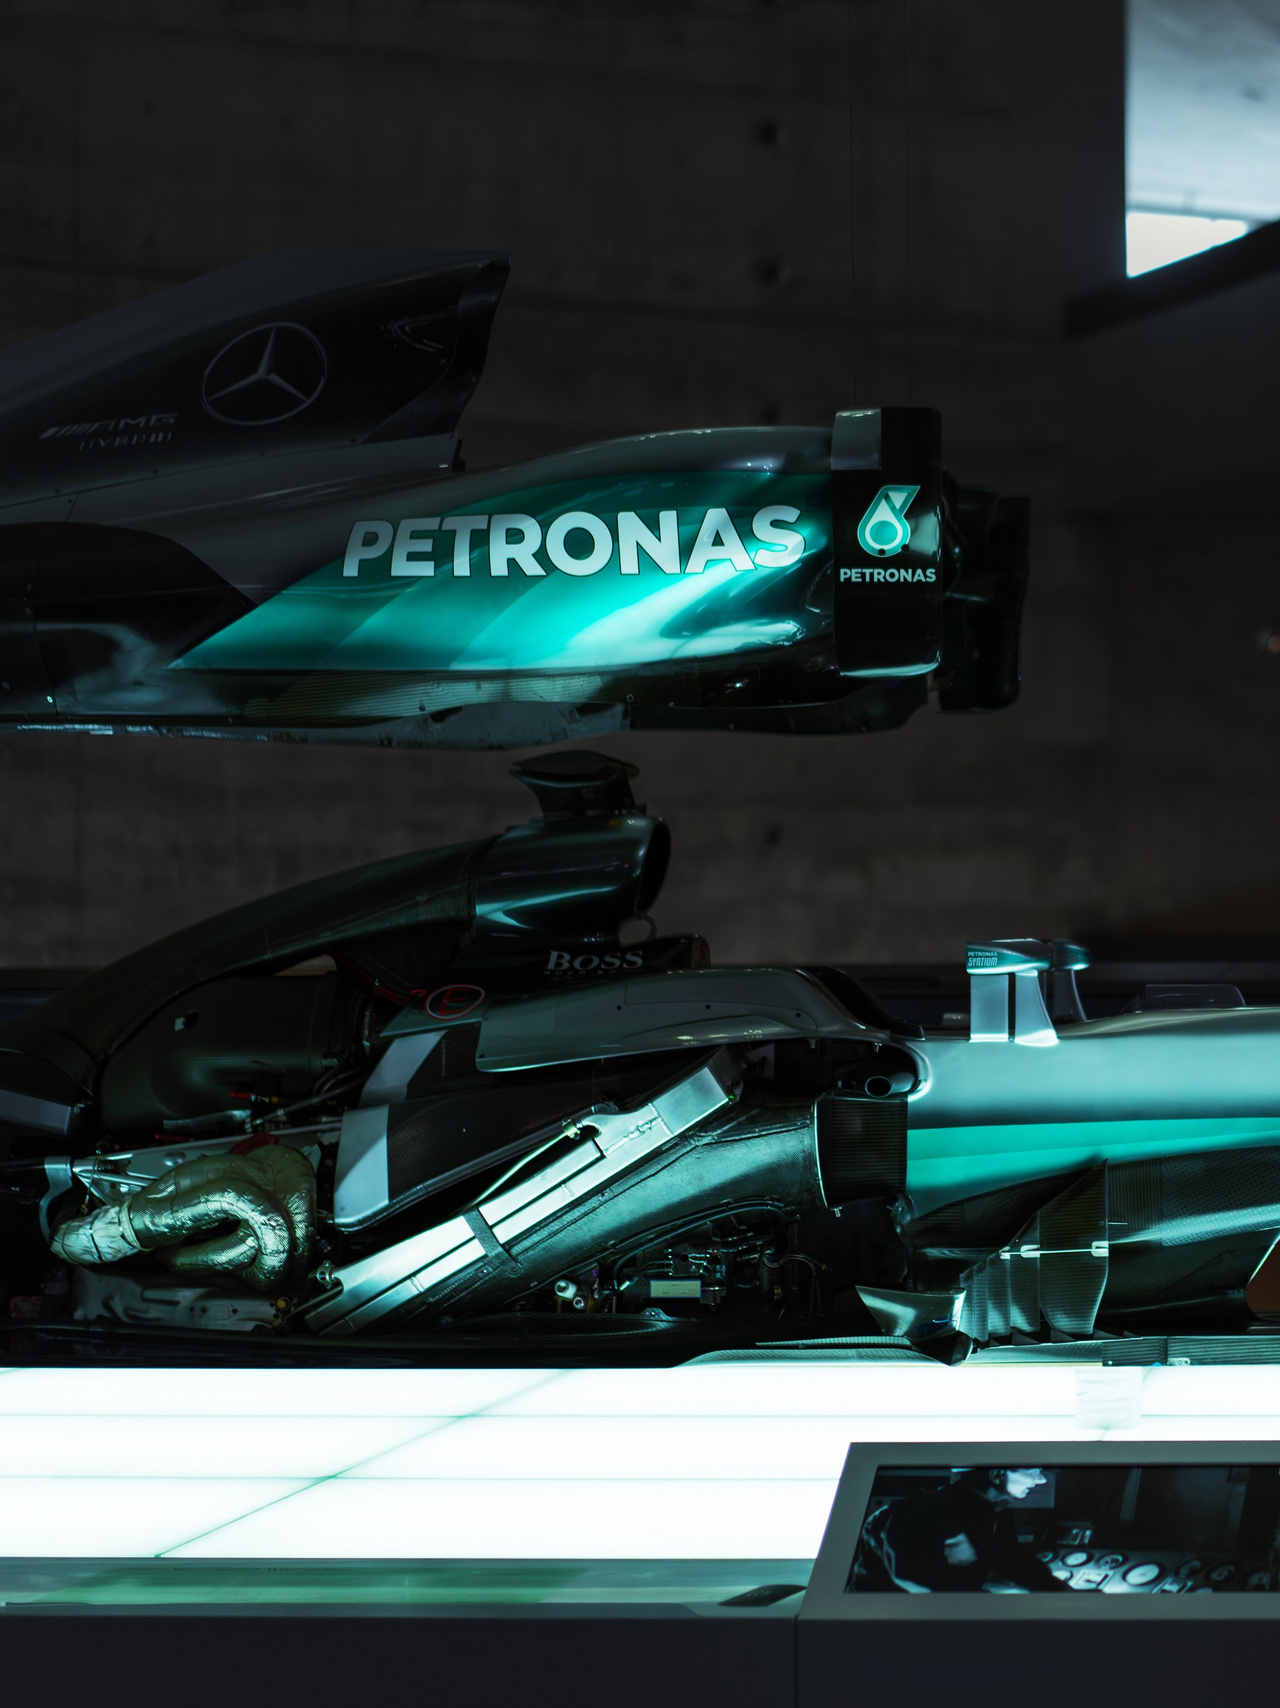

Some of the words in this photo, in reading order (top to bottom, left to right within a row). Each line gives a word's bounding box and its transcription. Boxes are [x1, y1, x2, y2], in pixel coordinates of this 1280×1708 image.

[342, 504, 806, 578] PETRONAS
[839, 568, 937, 582] PETRONAS
[545, 949, 644, 971] BOSS
